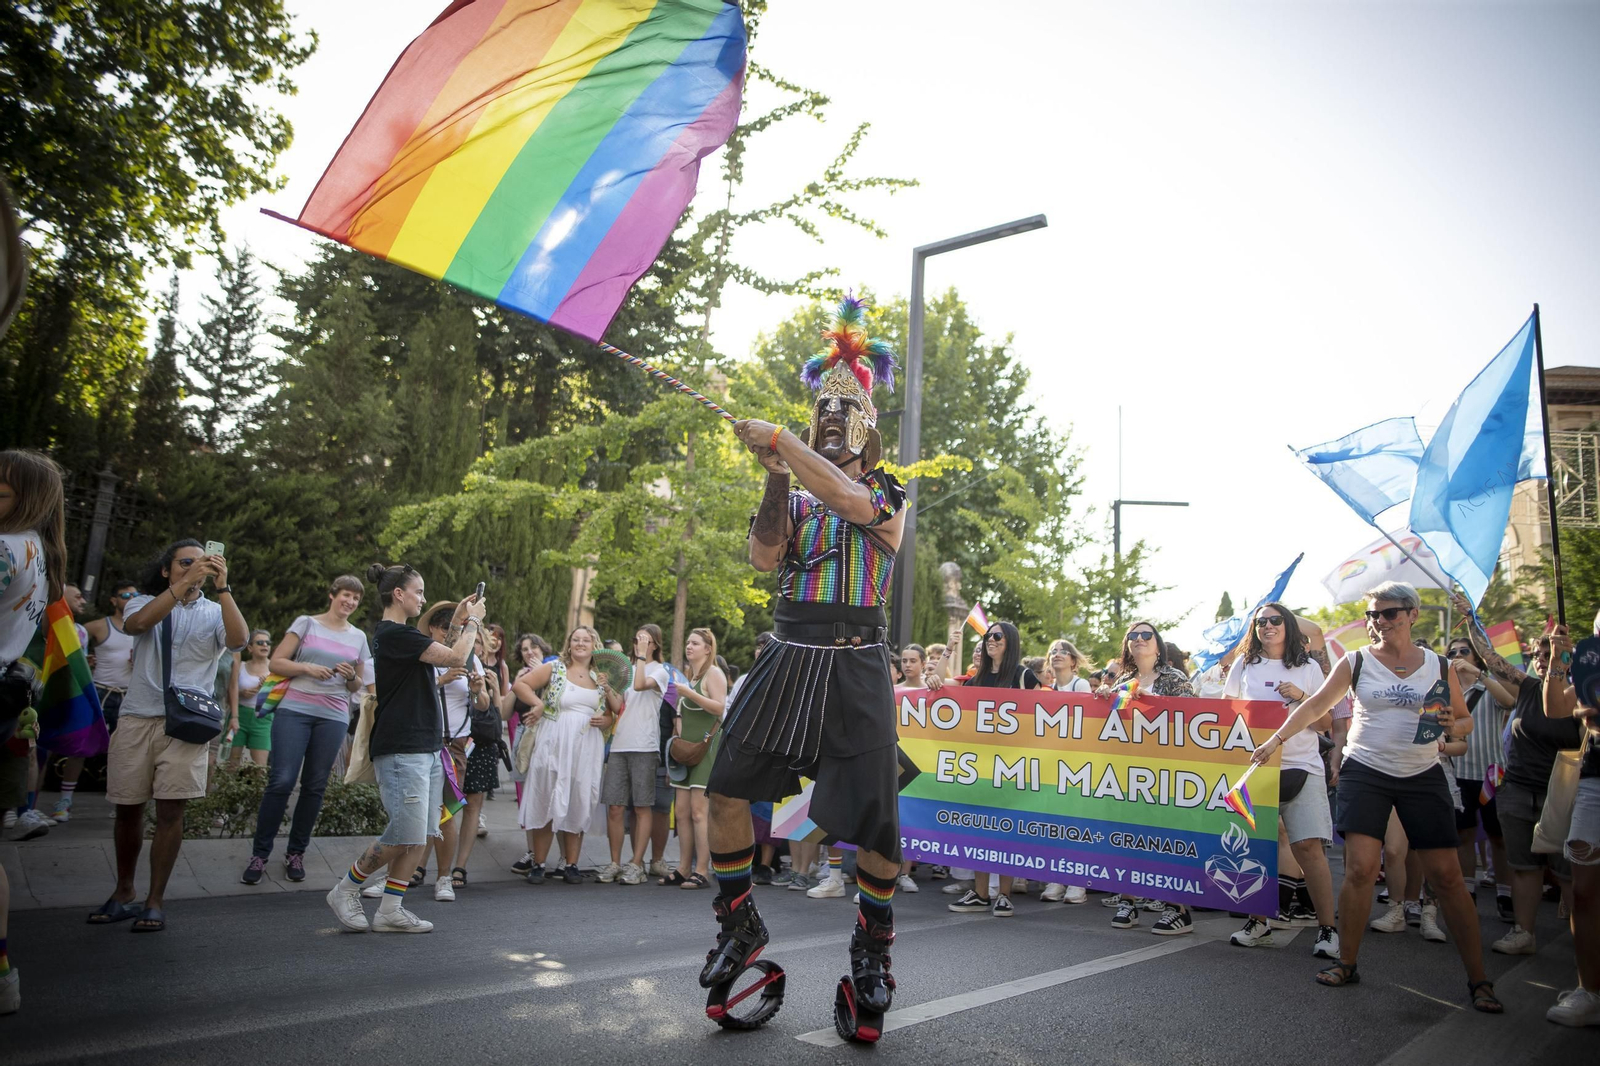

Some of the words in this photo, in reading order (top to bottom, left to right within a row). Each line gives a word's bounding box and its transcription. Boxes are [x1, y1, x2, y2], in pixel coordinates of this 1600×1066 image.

[901, 695, 962, 730] NO
[976, 700, 1019, 734] ES
[1034, 702, 1083, 739] MI
[1098, 708, 1262, 752] AMIGA
[936, 750, 978, 785] ES
[993, 754, 1040, 792] MI
[1057, 759, 1236, 813] MARIDA
[936, 809, 1014, 832] ORGULLO
[1017, 820, 1105, 844] LGTBIQA+
[1109, 831, 1199, 858] GRANADA
[911, 838, 940, 854] POR
[943, 843, 960, 857] LA
[963, 846, 1046, 869] VISIBILIDAD
[1050, 858, 1110, 880] LÉSBICA
[1115, 868, 1126, 881] Y
[1131, 870, 1204, 895] BISEXUAL
